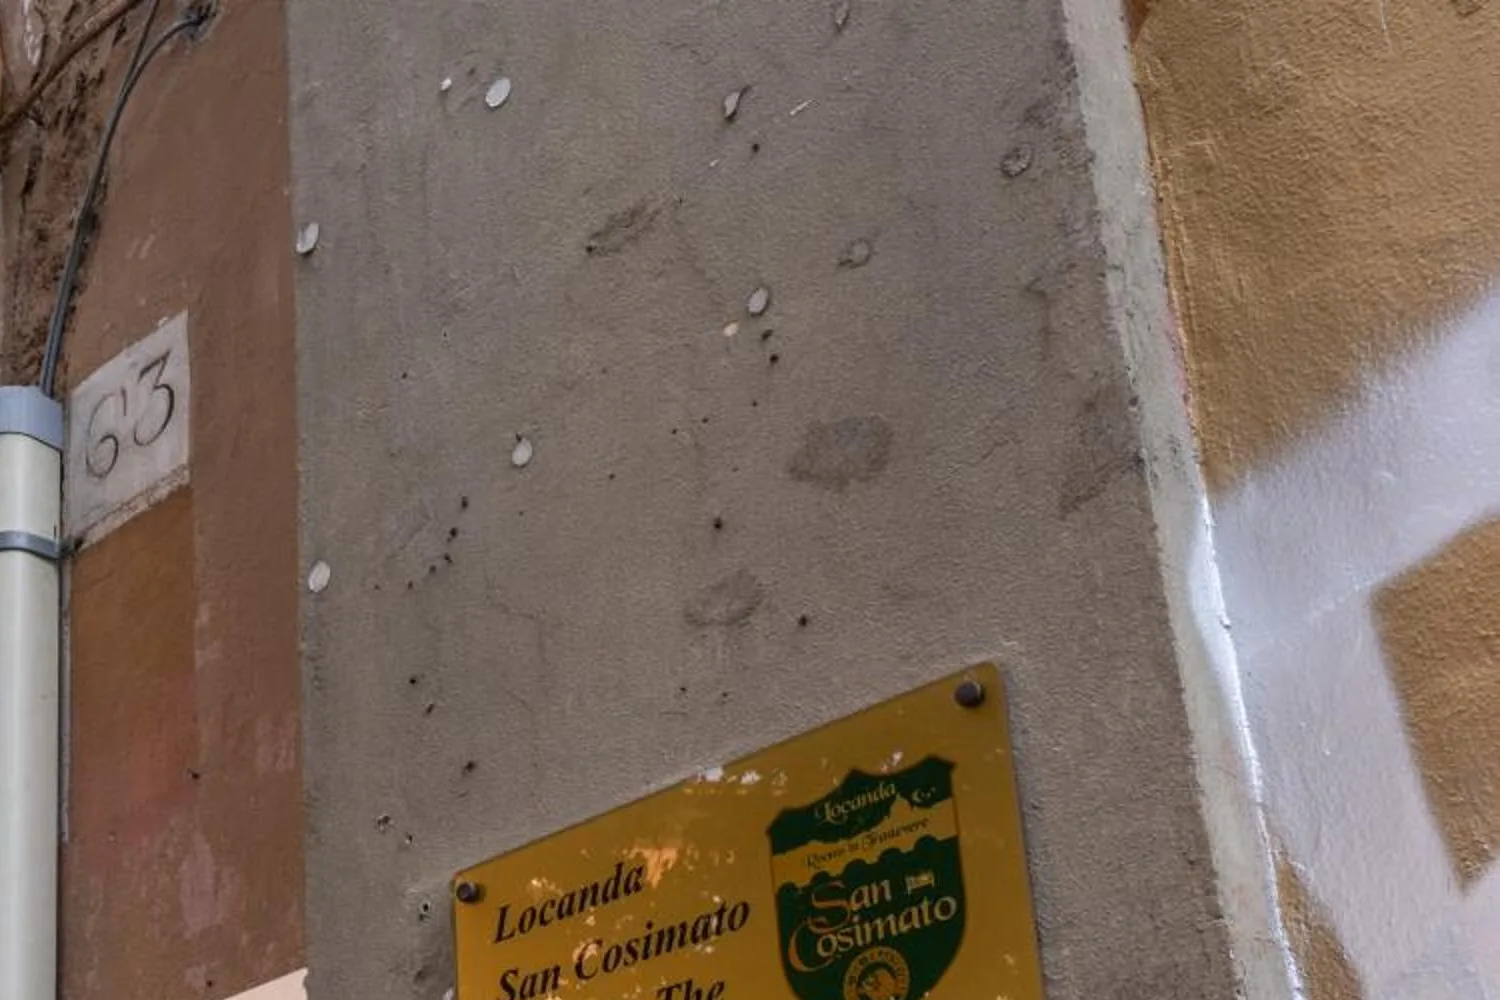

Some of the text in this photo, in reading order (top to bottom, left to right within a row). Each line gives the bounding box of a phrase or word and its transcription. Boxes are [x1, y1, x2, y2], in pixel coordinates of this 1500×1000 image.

[85, 348, 175, 480] 63
[815, 780, 898, 825] Locanda
[491, 861, 645, 945] Locanda
[573, 895, 750, 982] Cosimato
[788, 895, 957, 973] Cosimato
[808, 878, 892, 935] San
